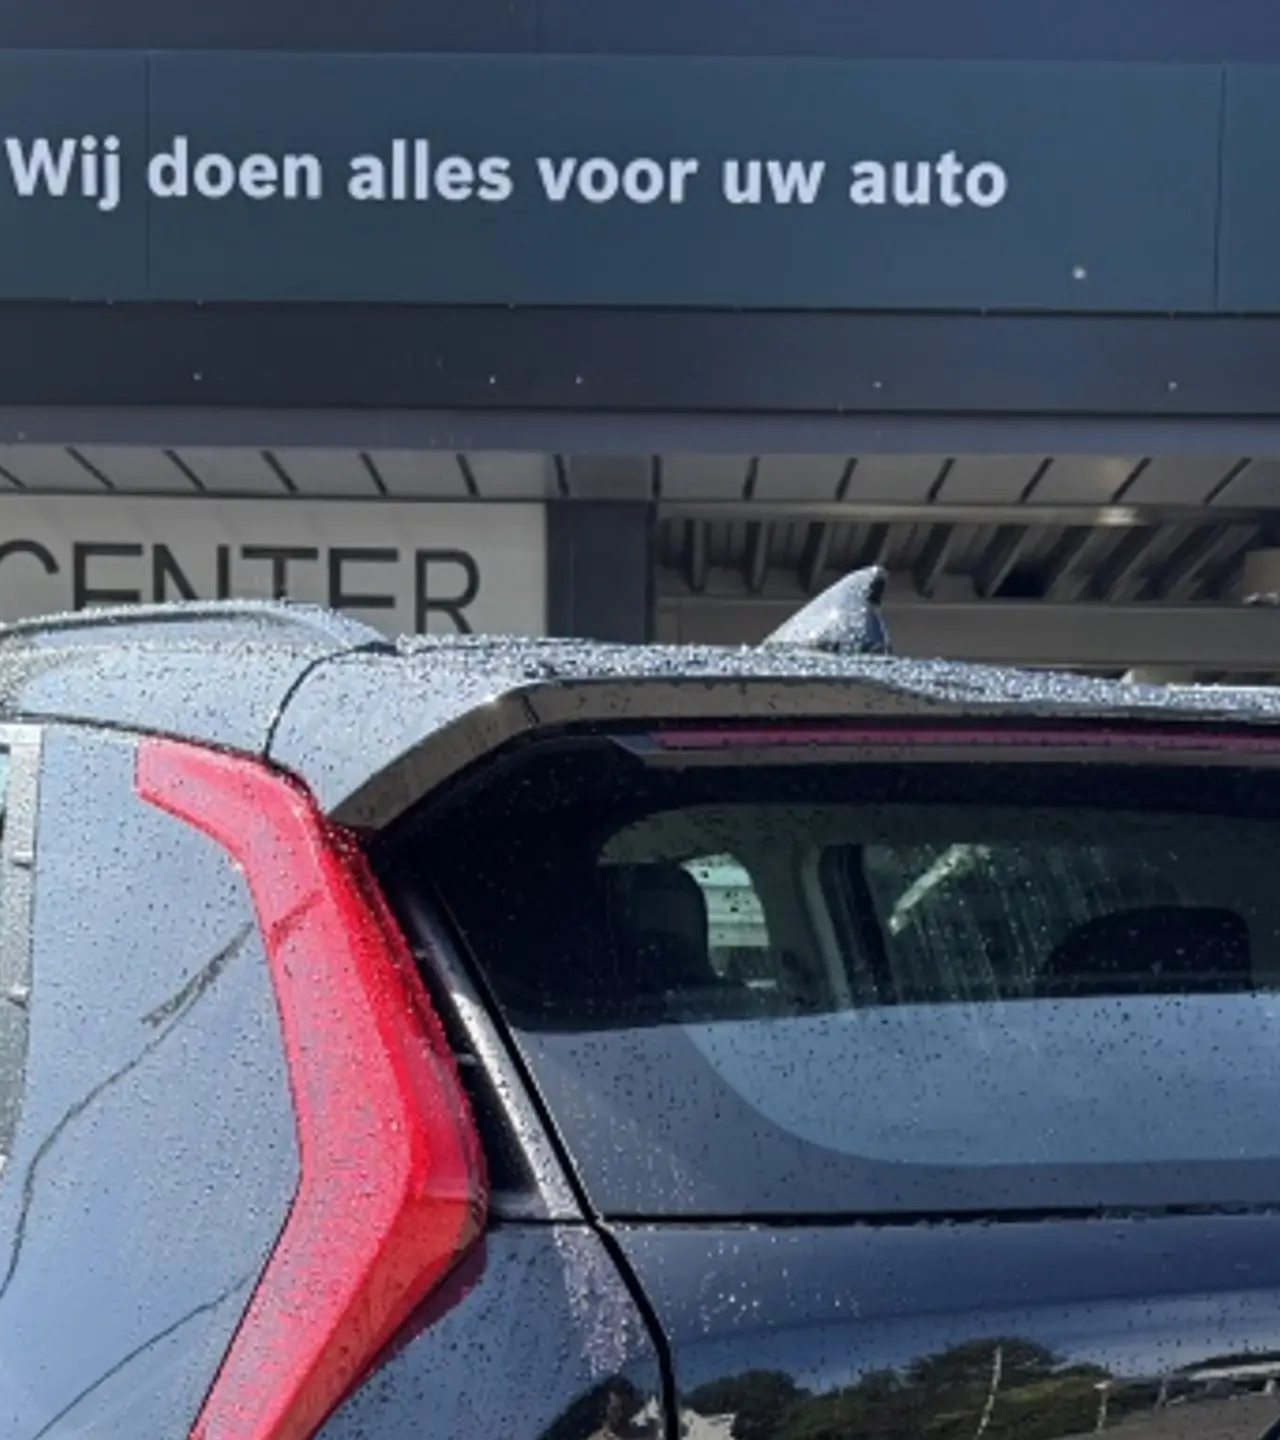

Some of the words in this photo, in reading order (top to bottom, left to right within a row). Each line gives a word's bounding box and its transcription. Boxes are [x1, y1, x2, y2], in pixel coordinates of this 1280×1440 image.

[4, 136, 121, 211] Wij
[146, 136, 322, 200] doen
[347, 138, 513, 202] alles
[536, 150, 699, 203] voor
[722, 154, 826, 205] uw
[848, 152, 1008, 208] auto
